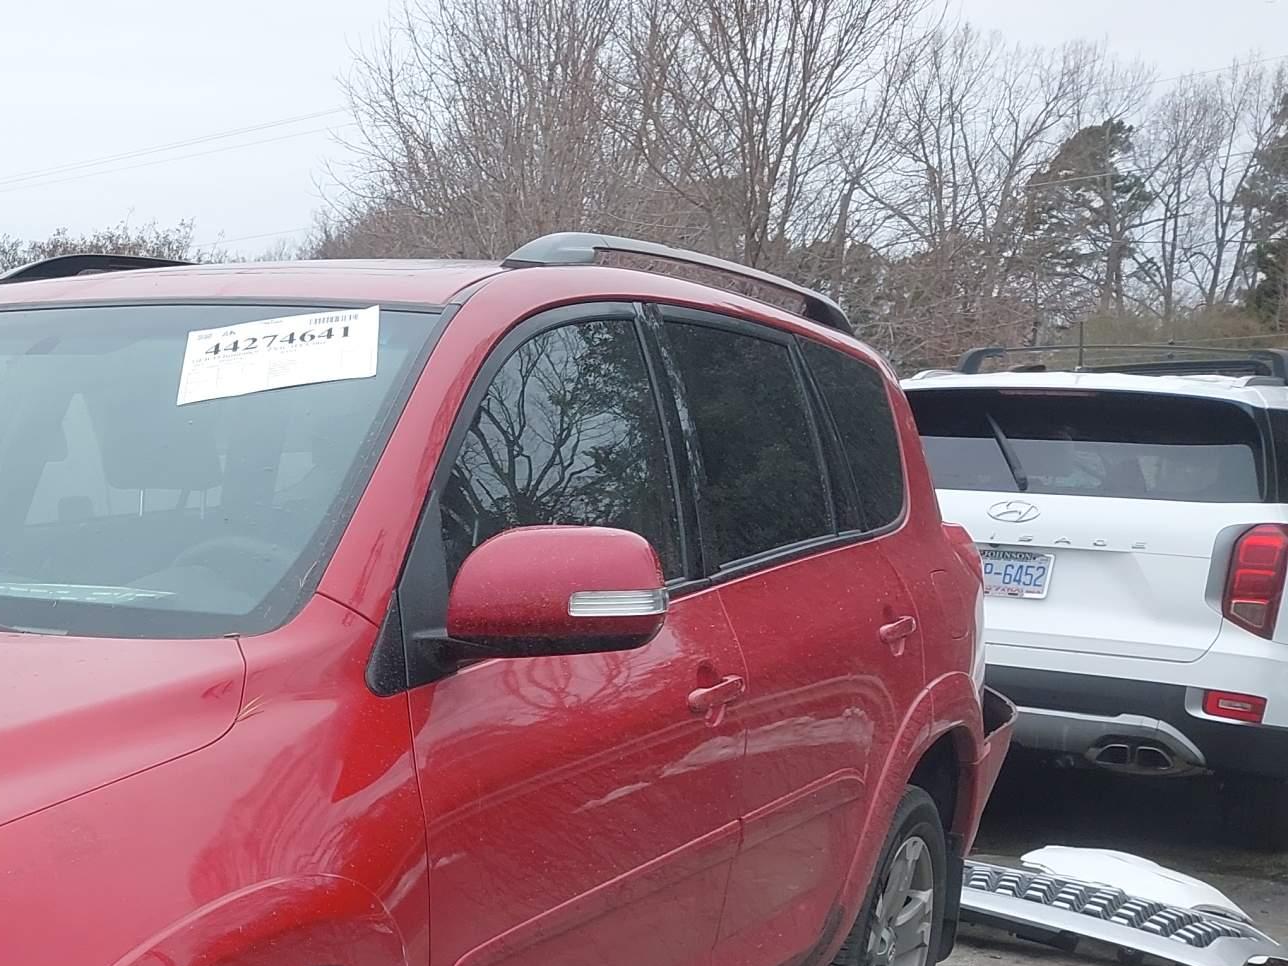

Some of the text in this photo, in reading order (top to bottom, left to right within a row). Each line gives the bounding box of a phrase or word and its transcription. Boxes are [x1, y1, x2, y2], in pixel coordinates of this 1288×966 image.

[205, 326, 350, 356] 44274641
[983, 550, 1032, 560] JOHNSON
[984, 562, 1046, 587] P-6452
